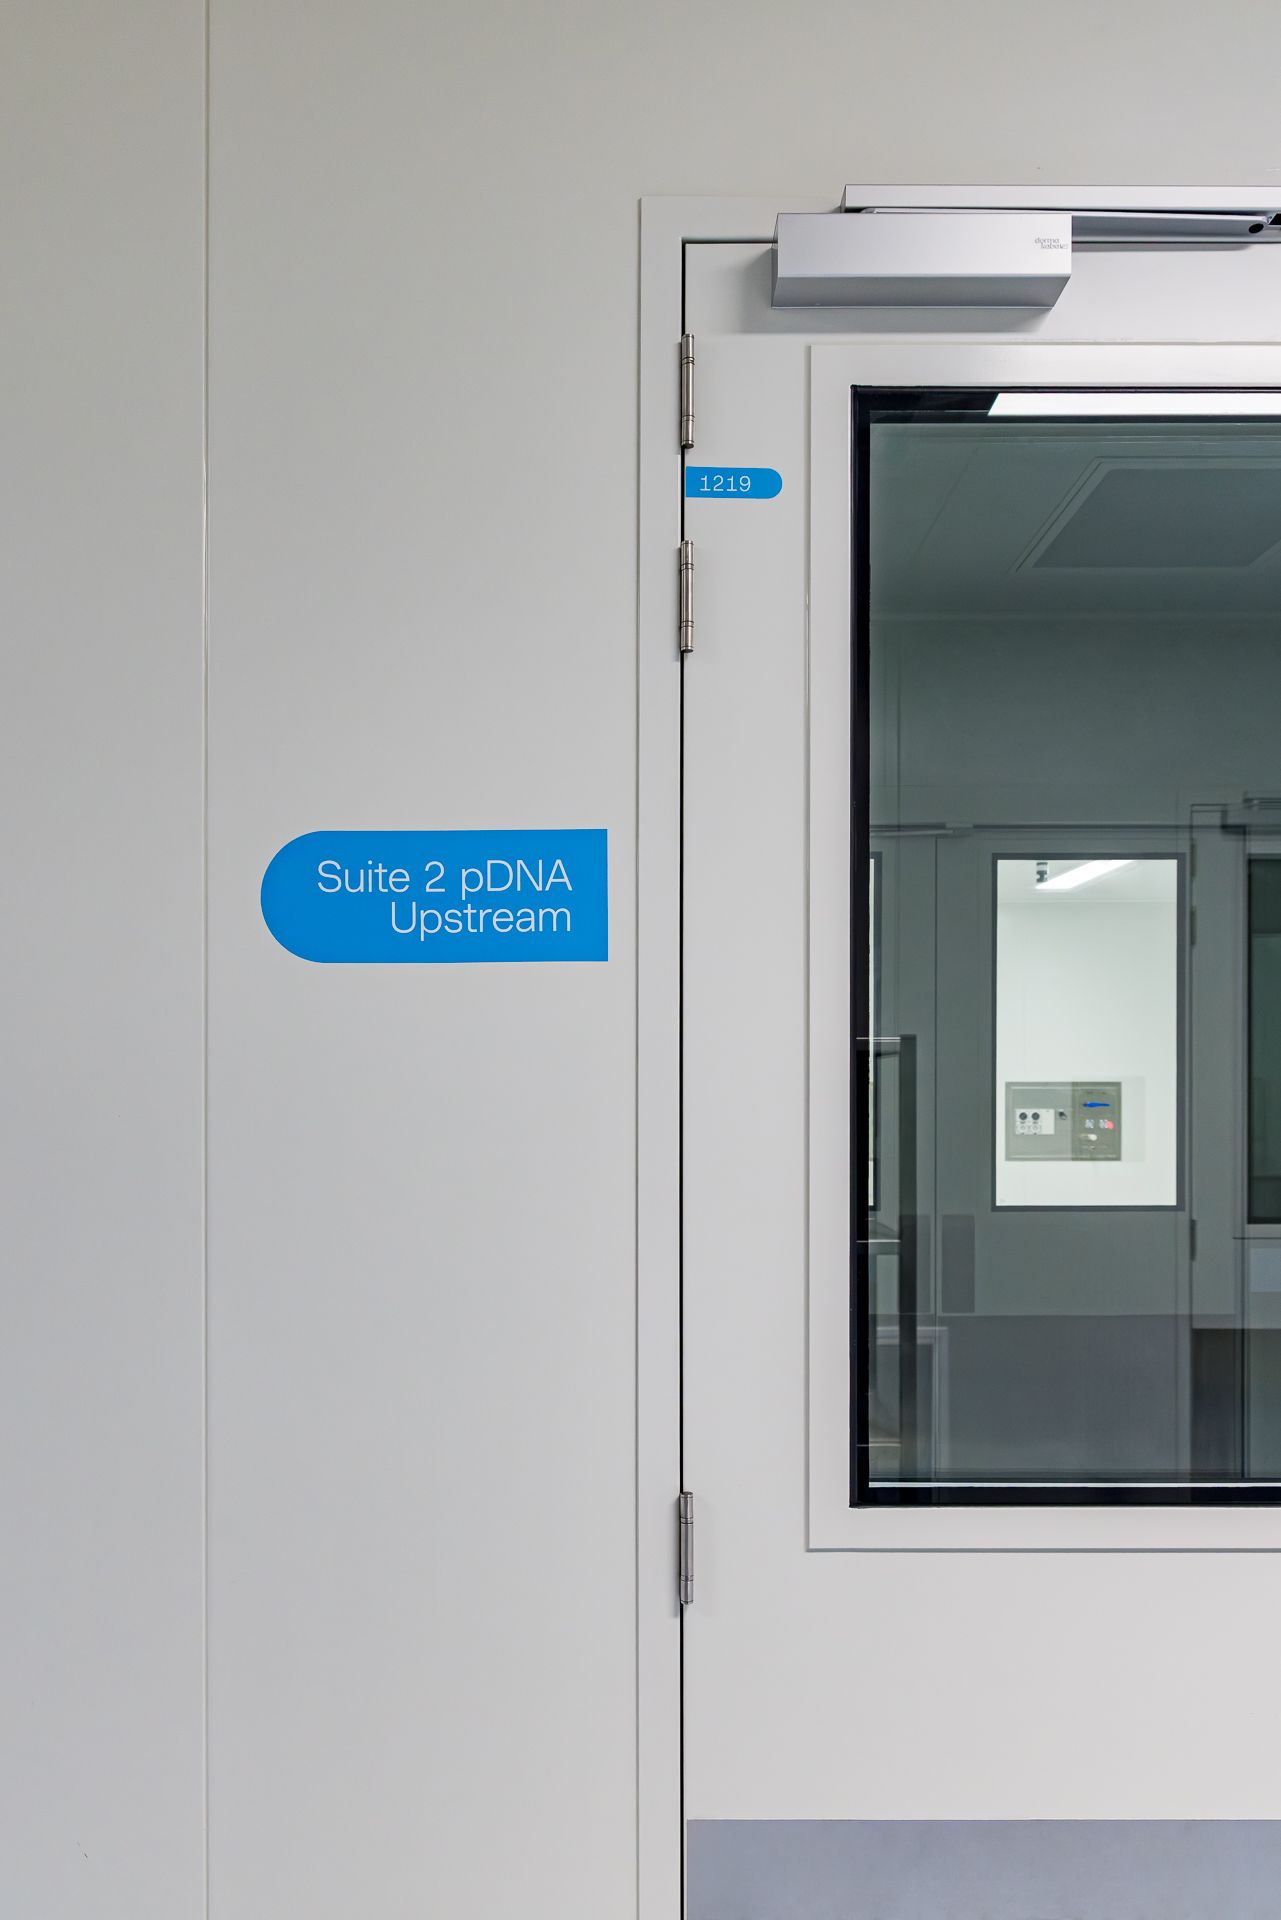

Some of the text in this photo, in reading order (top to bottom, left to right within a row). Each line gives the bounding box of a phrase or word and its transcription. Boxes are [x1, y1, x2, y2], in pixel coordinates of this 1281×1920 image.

[700, 475, 751, 492] 1219
[317, 859, 573, 900] Suite 2 pDNA
[391, 901, 571, 941] Upstream
